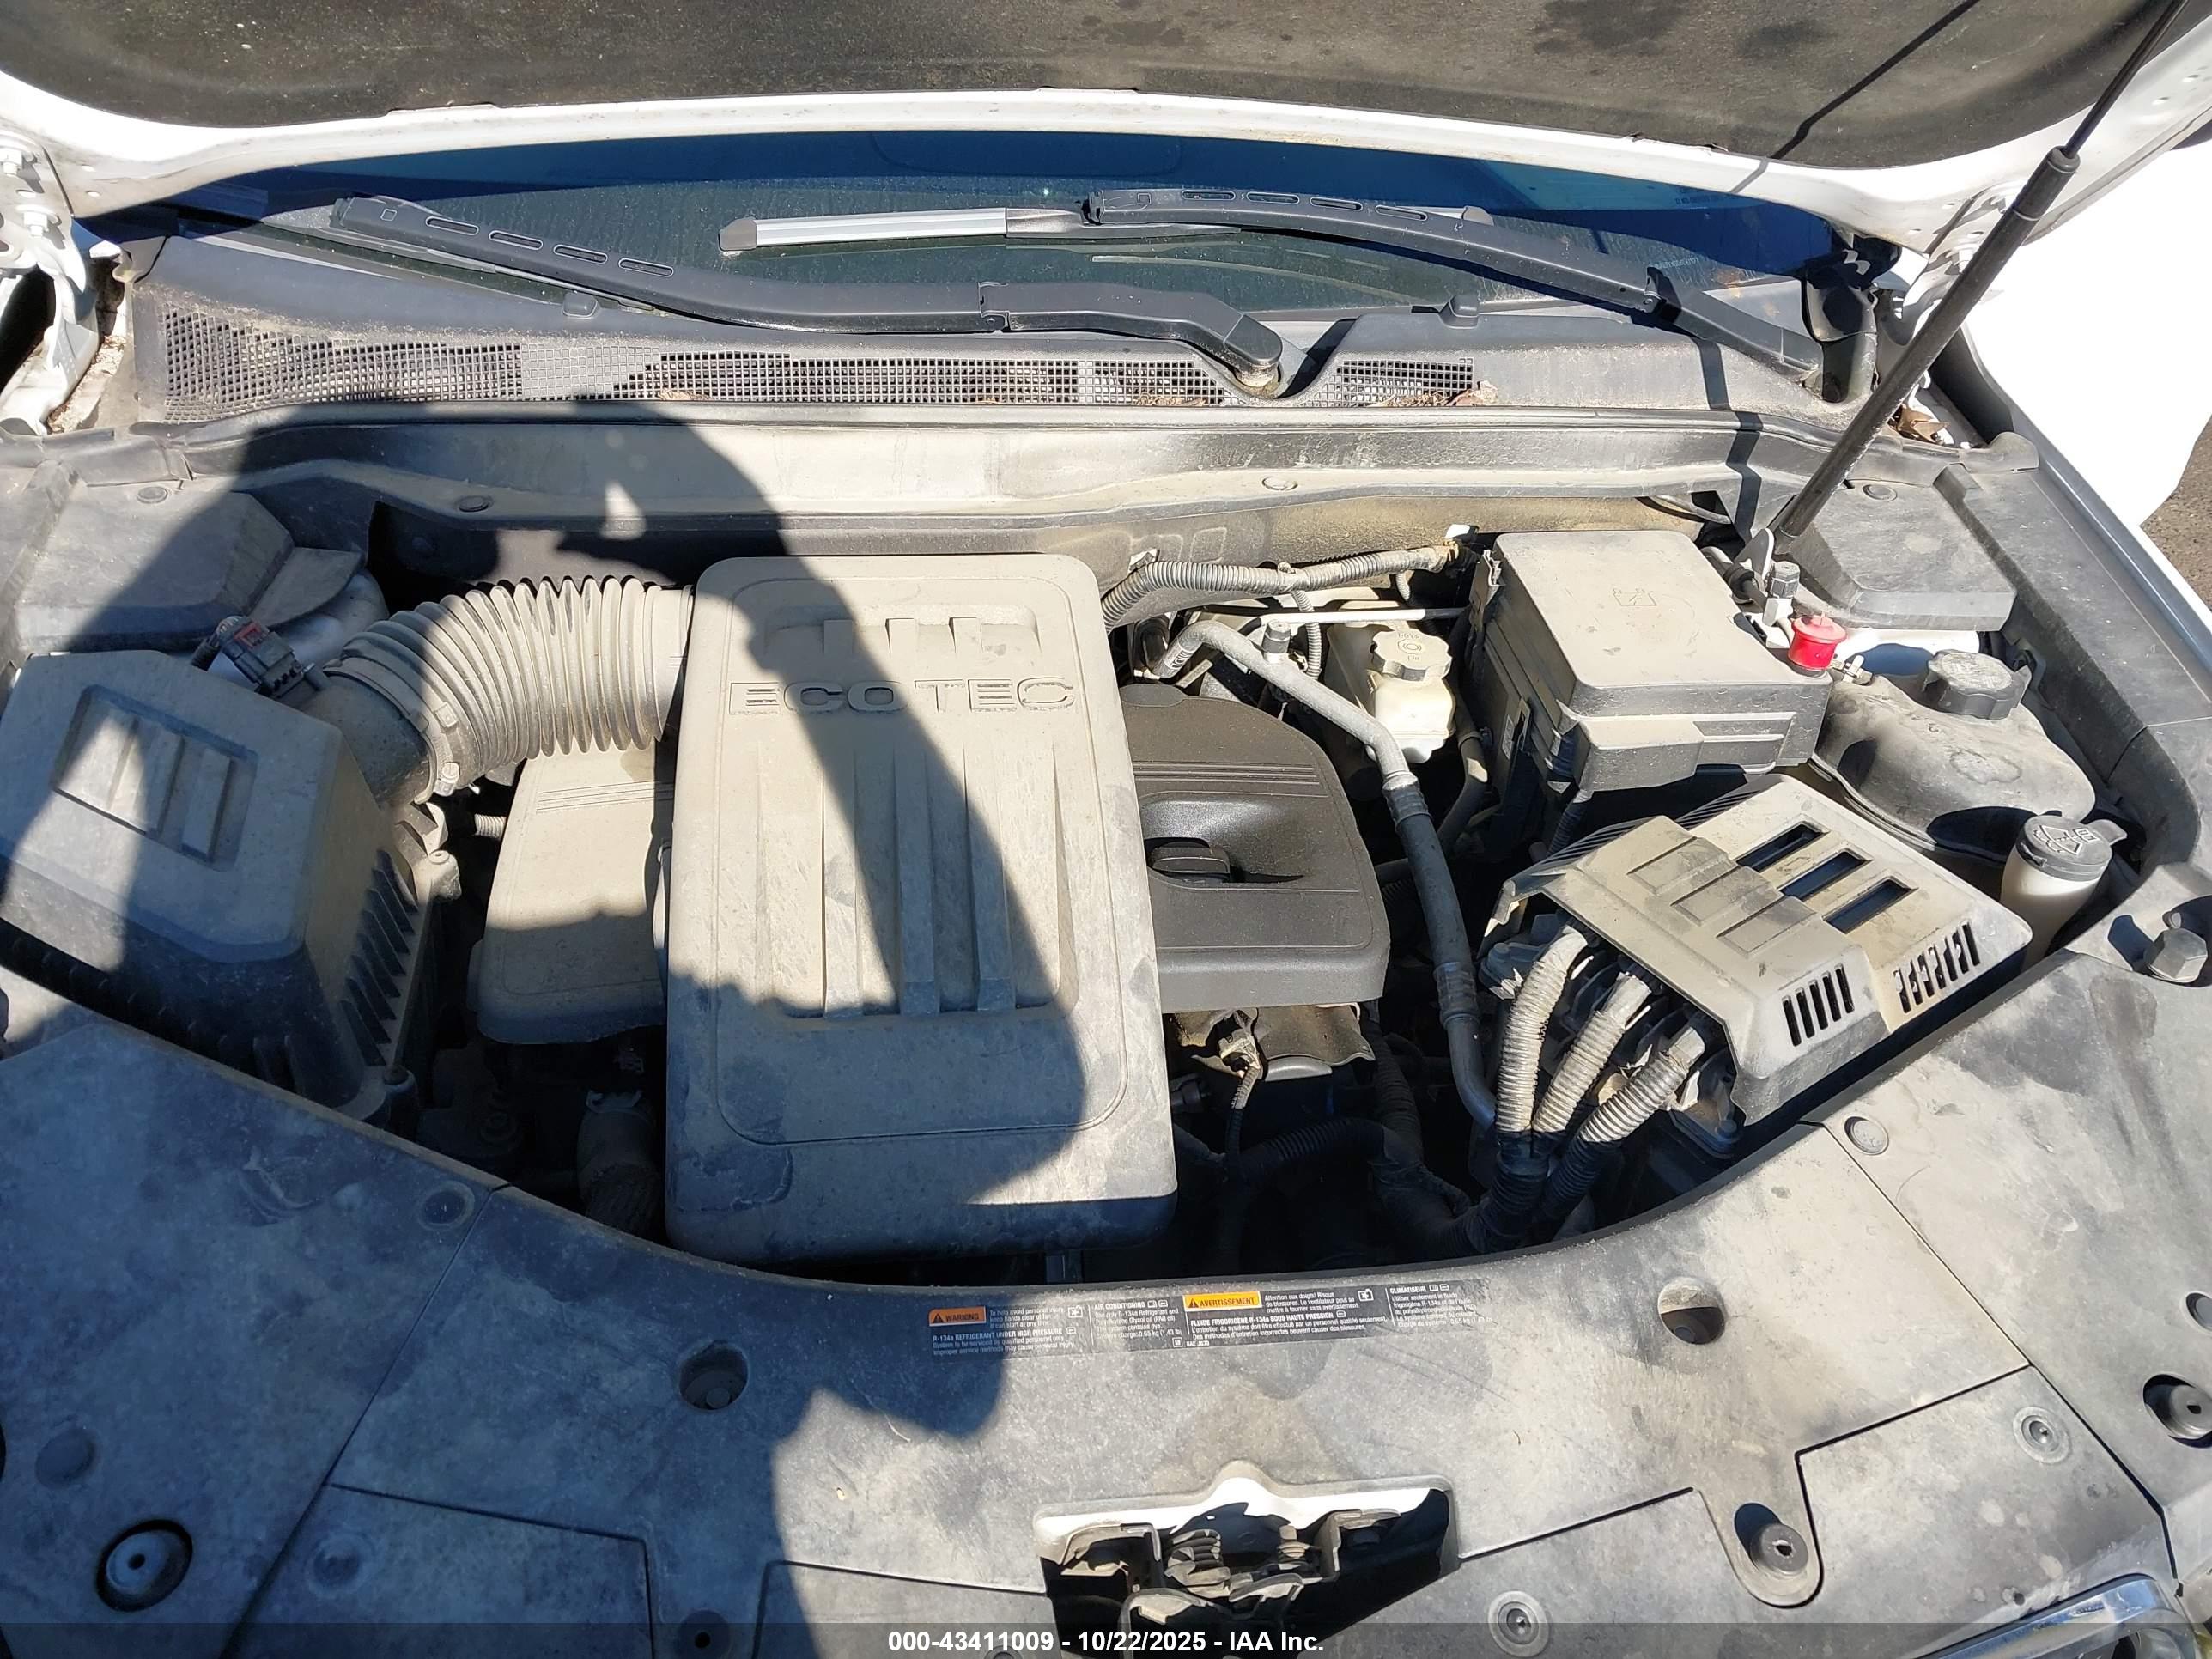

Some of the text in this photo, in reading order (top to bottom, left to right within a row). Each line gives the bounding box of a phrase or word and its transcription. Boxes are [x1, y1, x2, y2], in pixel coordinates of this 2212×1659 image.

[728, 677, 1076, 716] ECOTEC
[1389, 1285, 1426, 1294] CLIMATISEUR
[1105, 1301, 1146, 1310] CONDITIONING
[1200, 1297, 1255, 1306] AVERTISSEMENT
[945, 1313, 979, 1322] WARNING
[1032, 1328, 1063, 1336] PRESSURE
